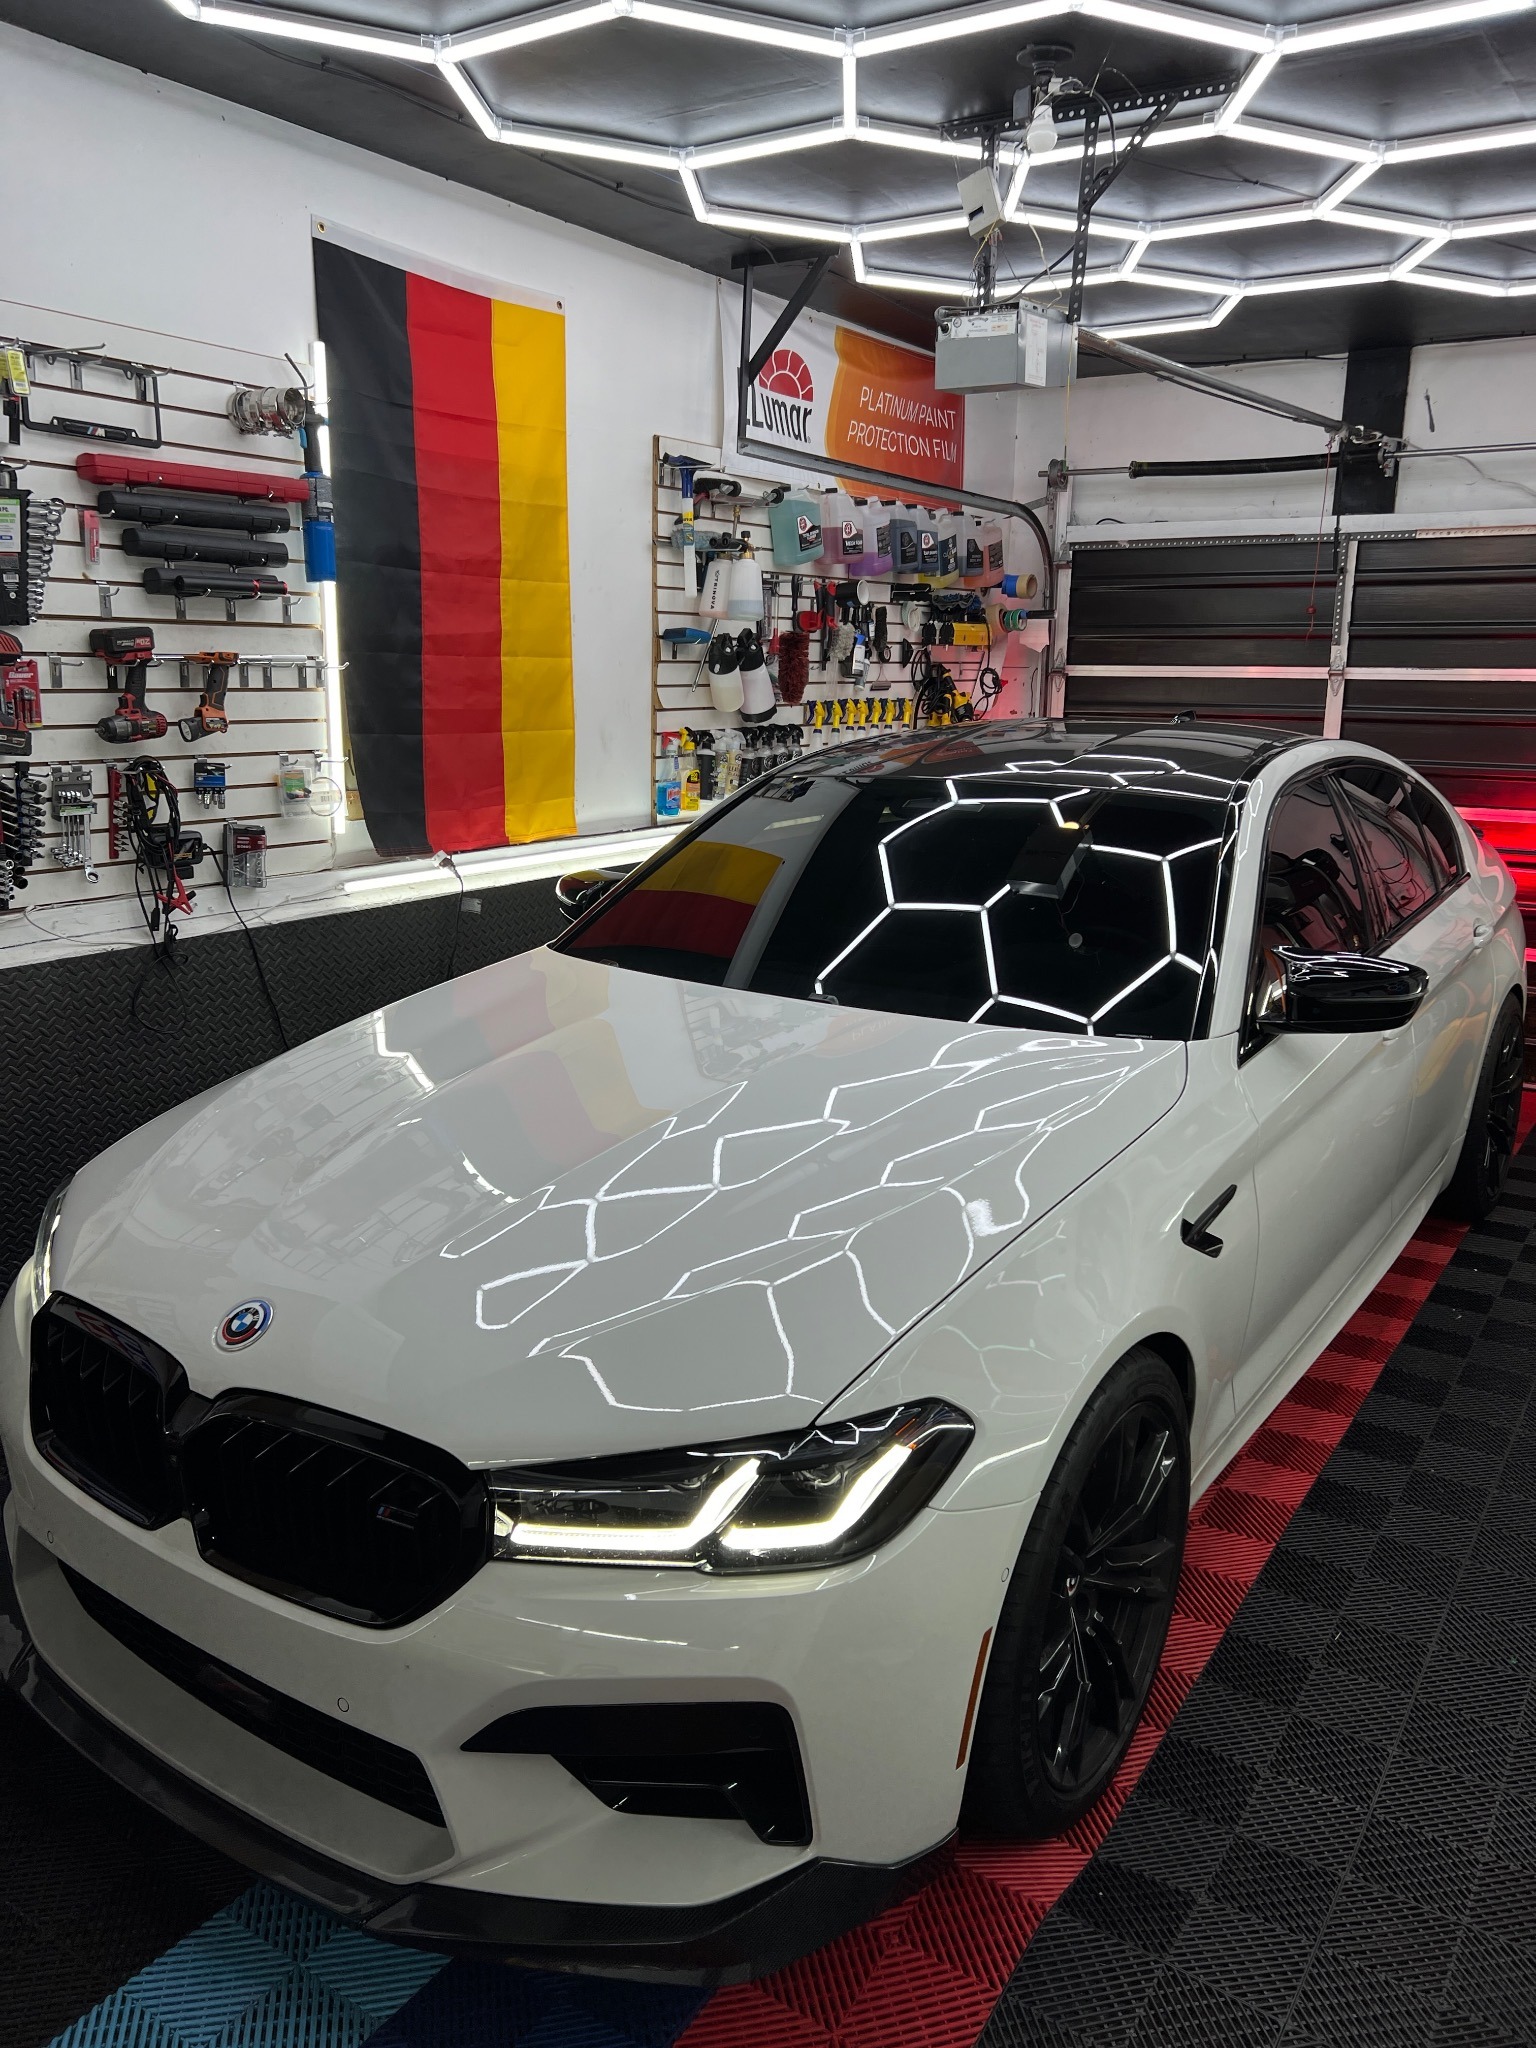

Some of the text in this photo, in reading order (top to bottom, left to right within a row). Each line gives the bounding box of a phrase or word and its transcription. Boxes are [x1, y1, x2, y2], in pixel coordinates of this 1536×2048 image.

[746, 384, 812, 443] Lumar
[859, 385, 956, 430] PLATINUM PAINT
[846, 420, 957, 463] PROTECTION FILM
[710, 577, 720, 610] TRINOVA
[8, 671, 34, 679] Bauer
